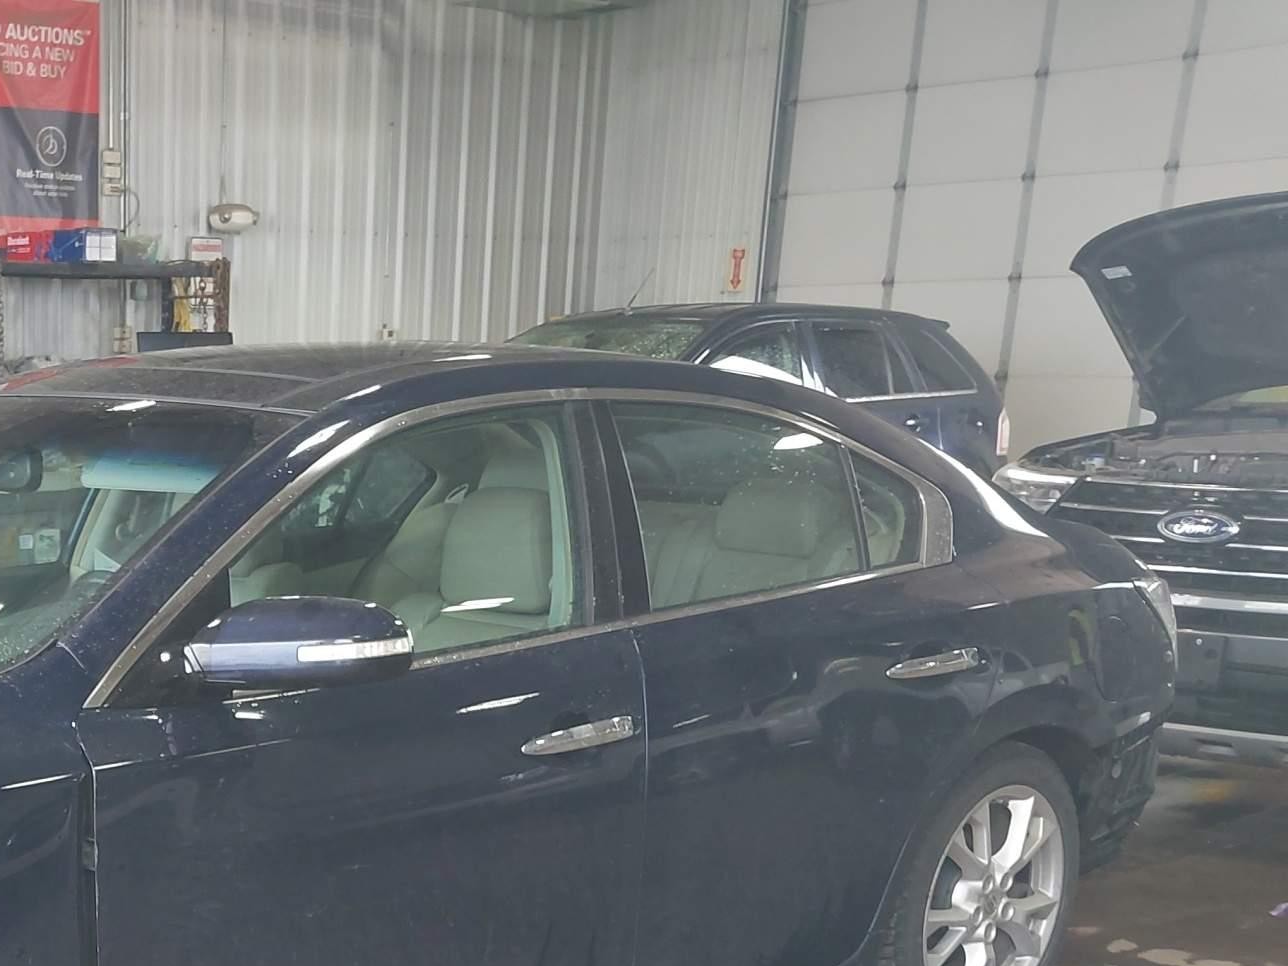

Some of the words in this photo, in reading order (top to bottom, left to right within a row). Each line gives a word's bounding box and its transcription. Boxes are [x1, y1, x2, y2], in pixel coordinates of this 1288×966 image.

[31, 46, 43, 59] A
[45, 47, 75, 62] NEW
[2, 61, 24, 75] BID
[26, 62, 36, 77] &
[39, 63, 66, 79] BUY
